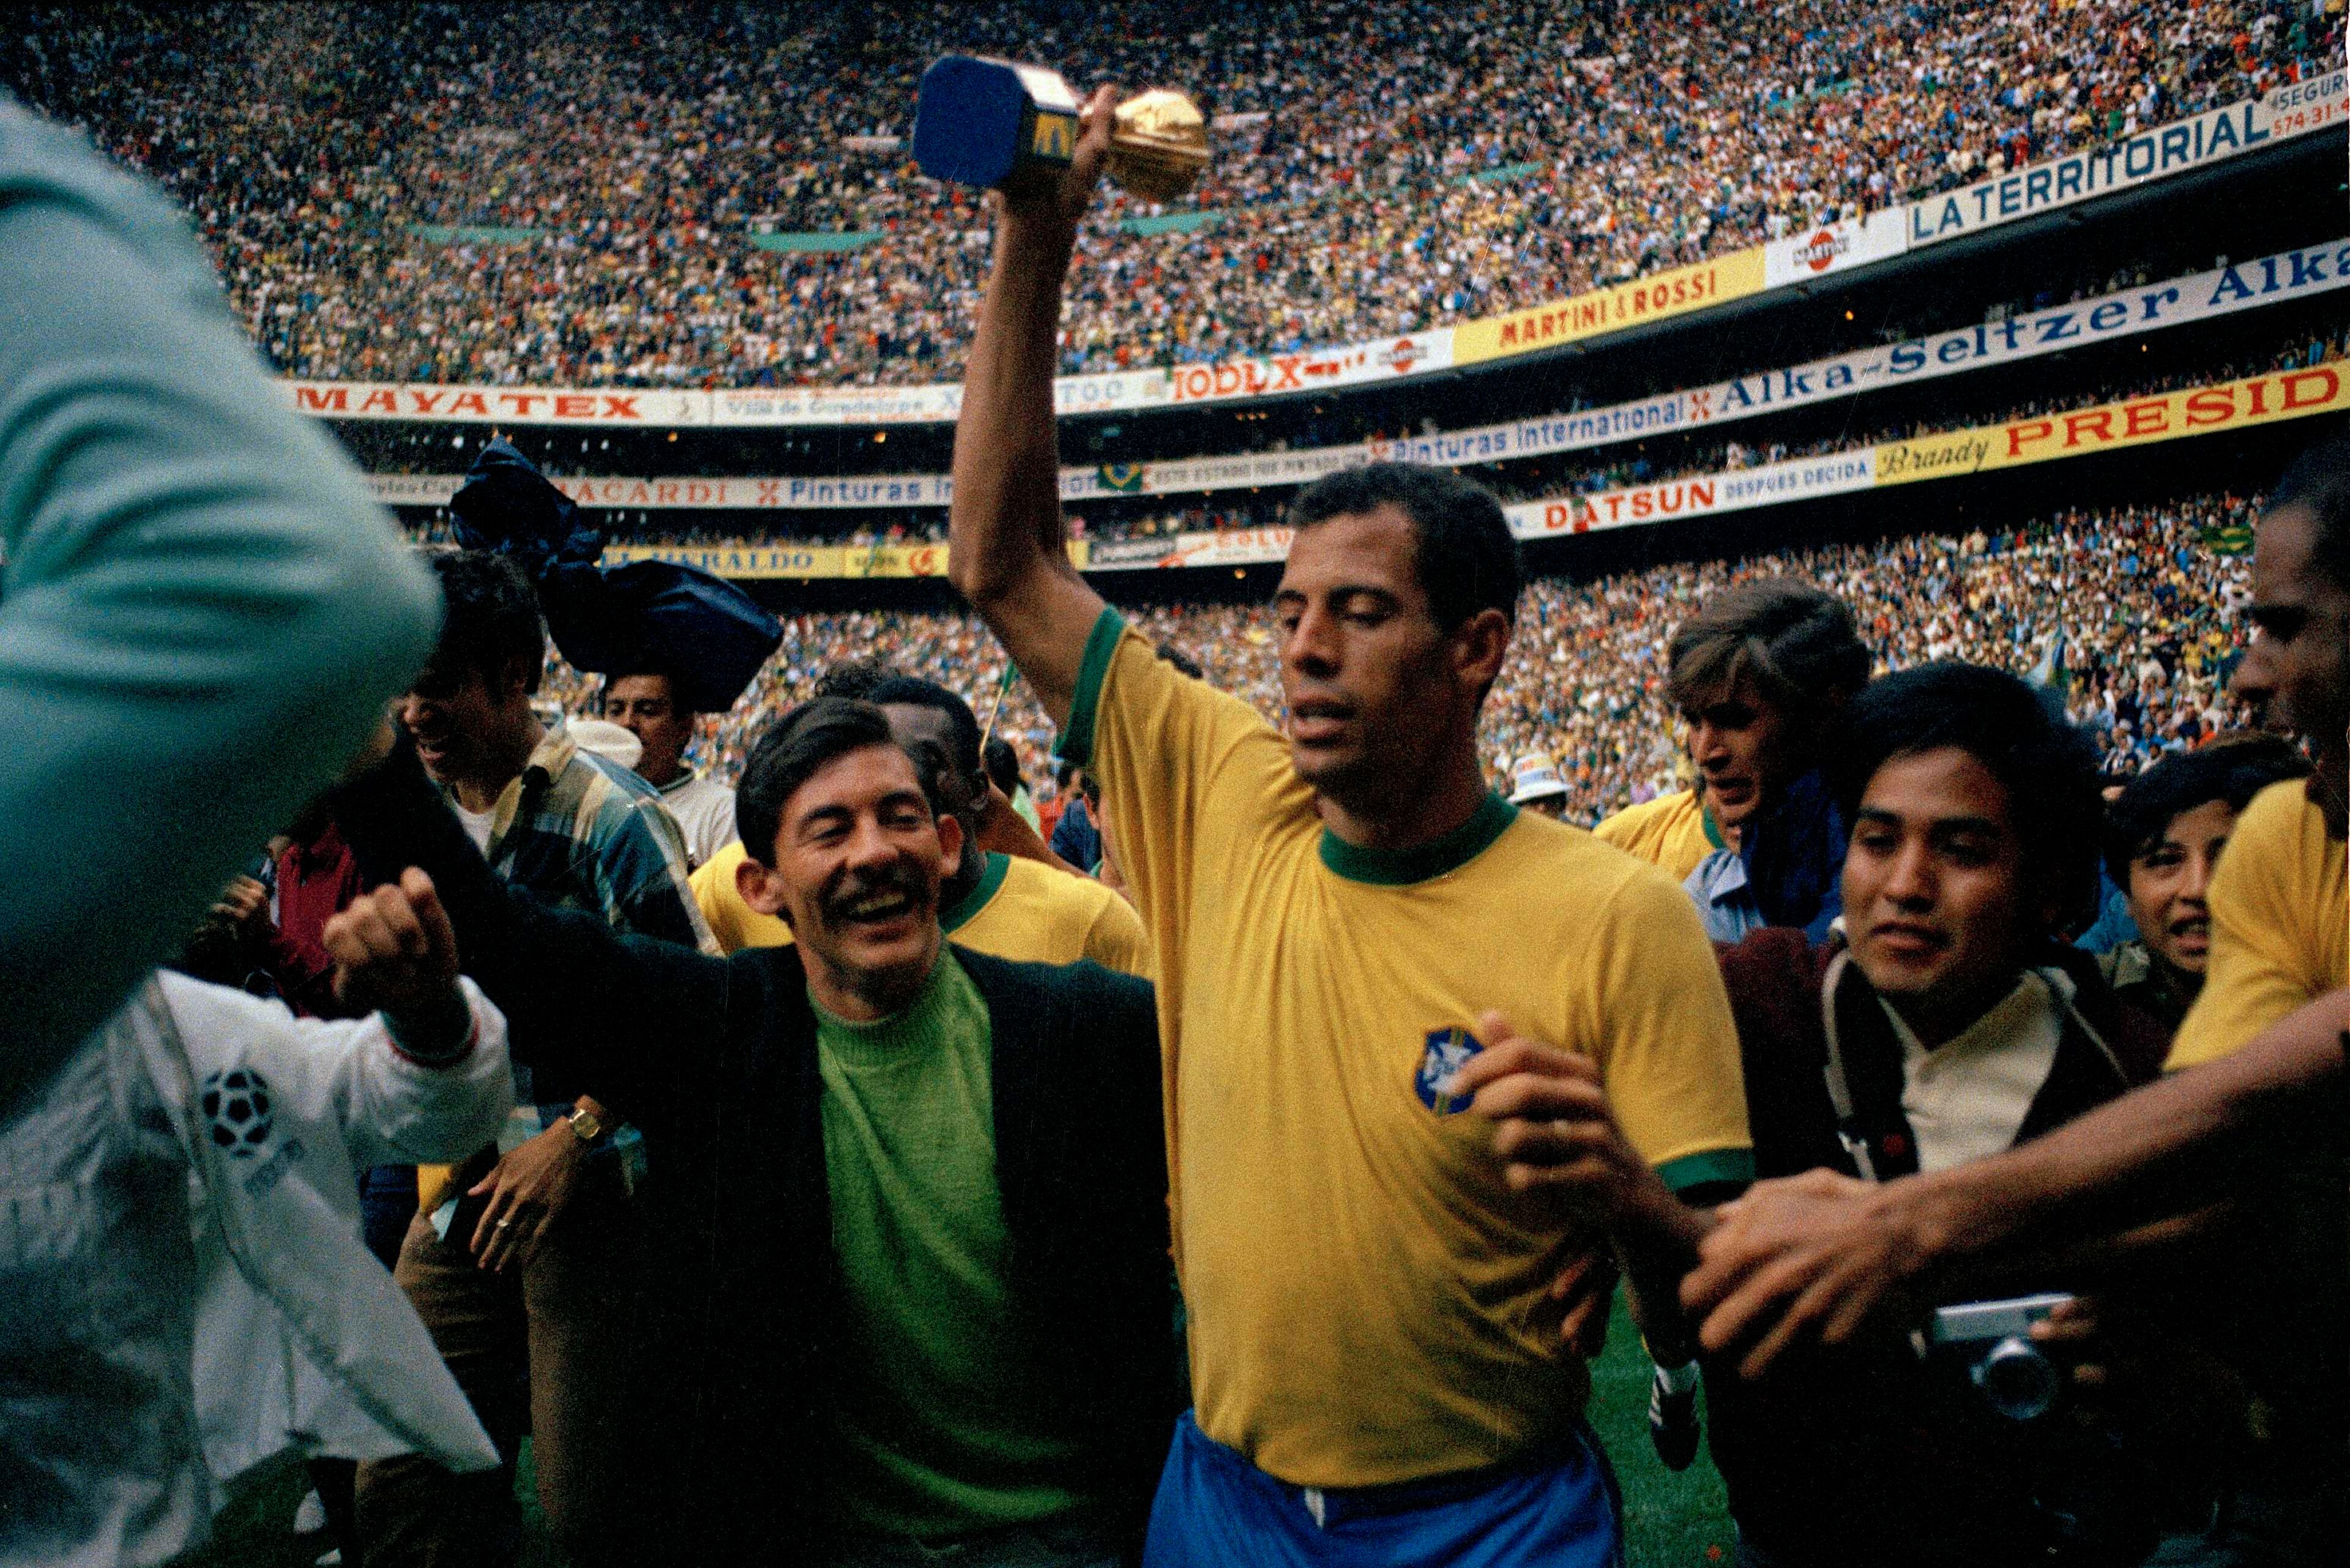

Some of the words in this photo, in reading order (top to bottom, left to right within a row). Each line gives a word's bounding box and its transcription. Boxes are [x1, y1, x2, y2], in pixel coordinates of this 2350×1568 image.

[1914, 197, 1963, 241] LA
[1972, 103, 2270, 221] TERRITORIAL
[1499, 297, 1607, 348] MARTINI
[1633, 267, 1716, 315] ROSSI
[1720, 286, 2179, 412] Alka-Seltzer
[297, 387, 640, 419] MAYATEX
[1516, 395, 1684, 449] International
[1876, 437, 1989, 479] Brandy
[2007, 368, 2340, 457] PRESID
[559, 482, 726, 503] ACARDI
[790, 479, 920, 504] Pinturas
[1545, 481, 1714, 529] DATSUN
[1805, 460, 1866, 485] DECIDA
